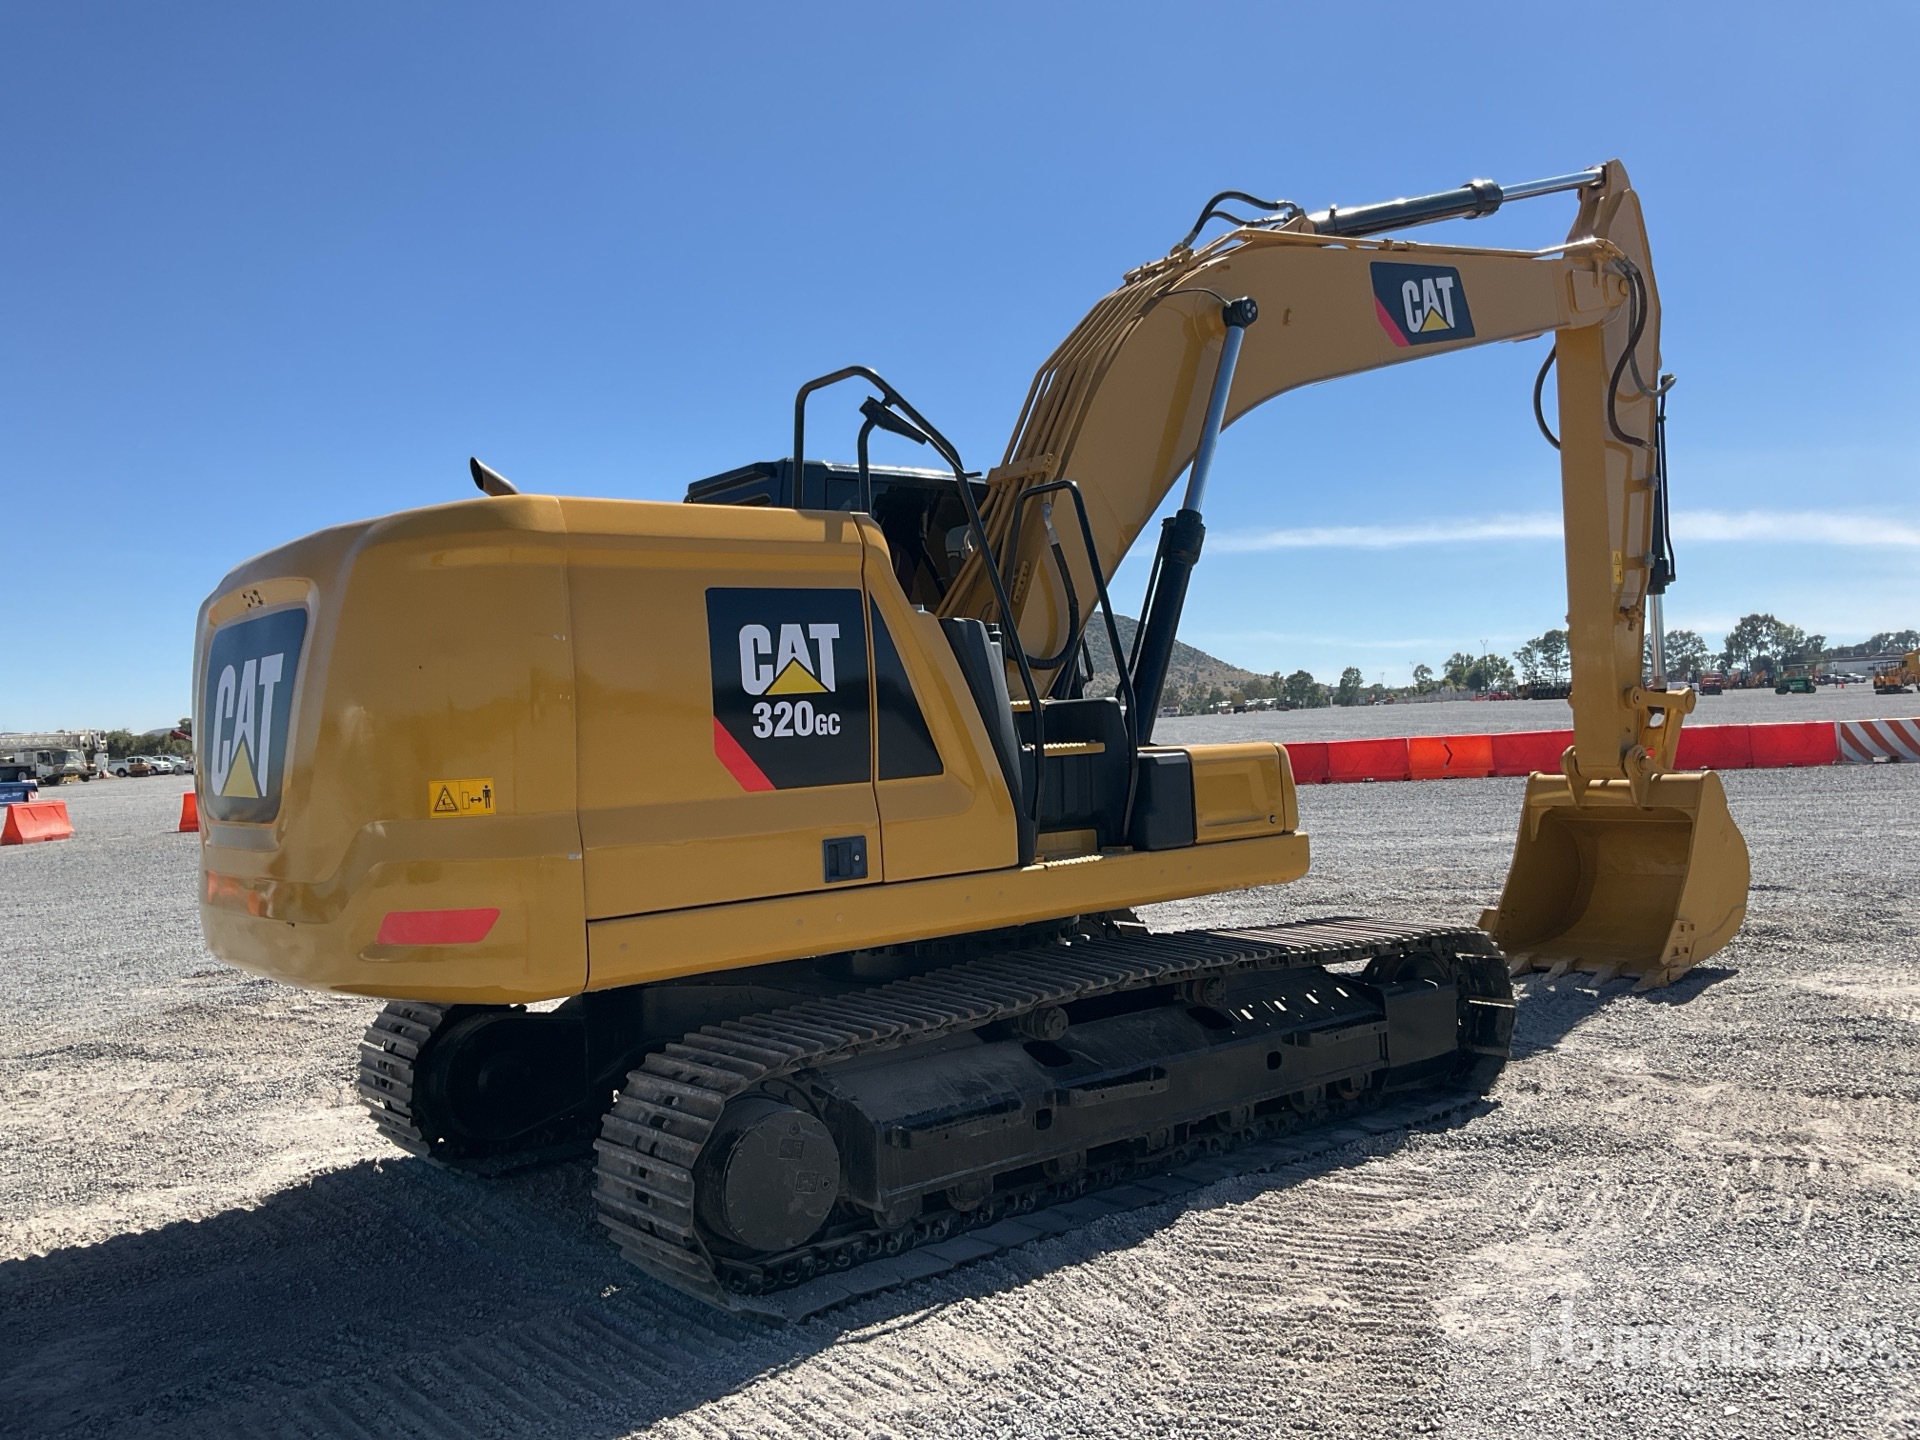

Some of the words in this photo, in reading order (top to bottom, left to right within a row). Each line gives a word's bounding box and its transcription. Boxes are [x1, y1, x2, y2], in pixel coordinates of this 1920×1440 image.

[1401, 276, 1455, 333] CAT
[738, 623, 840, 696] CAT
[211, 652, 284, 797] CAT
